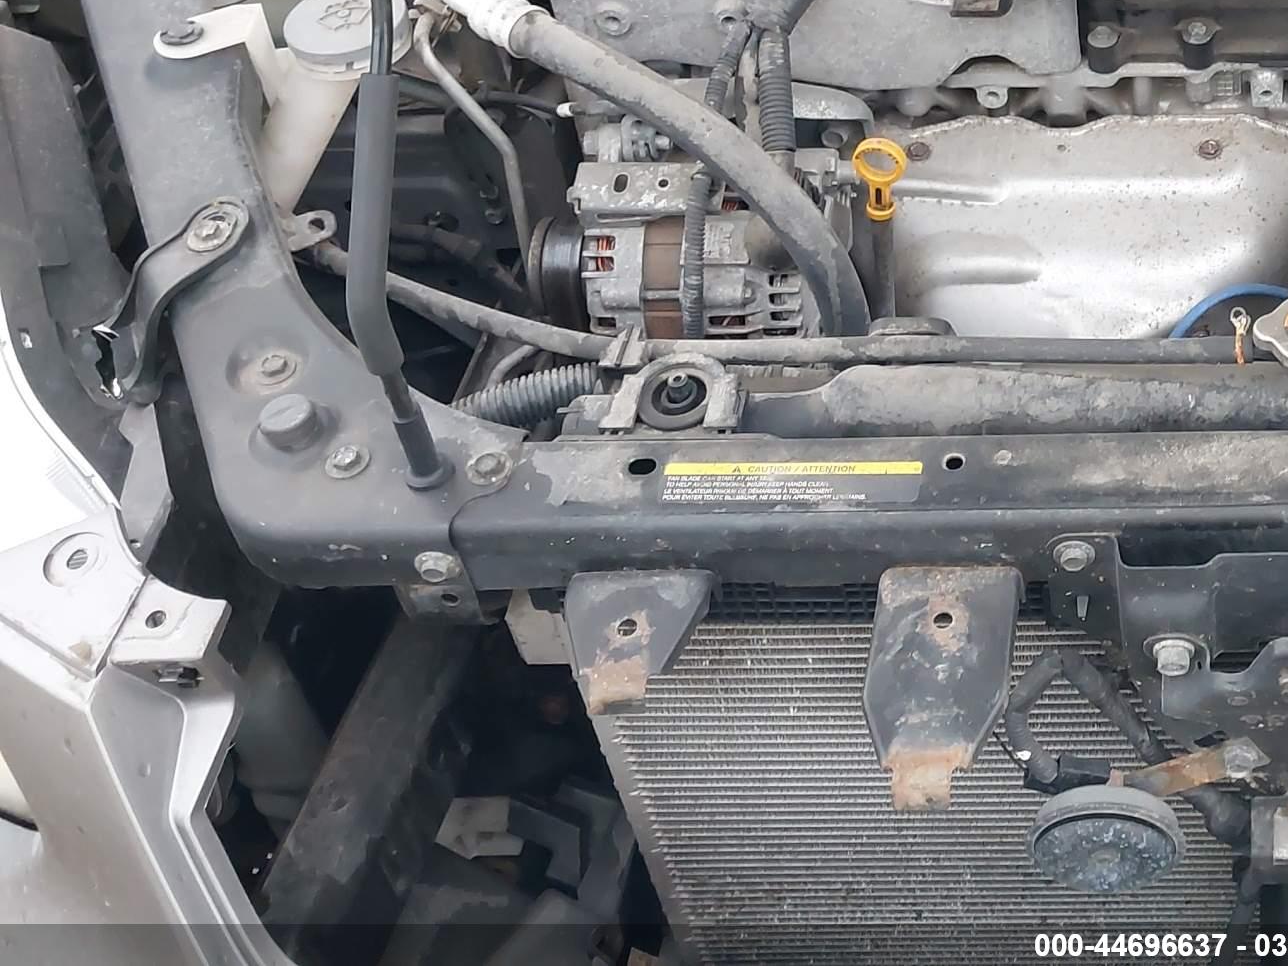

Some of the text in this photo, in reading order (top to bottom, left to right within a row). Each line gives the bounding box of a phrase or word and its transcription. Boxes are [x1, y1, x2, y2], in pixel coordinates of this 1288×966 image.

[747, 465, 856, 473] CAUTION / ATTENTION
